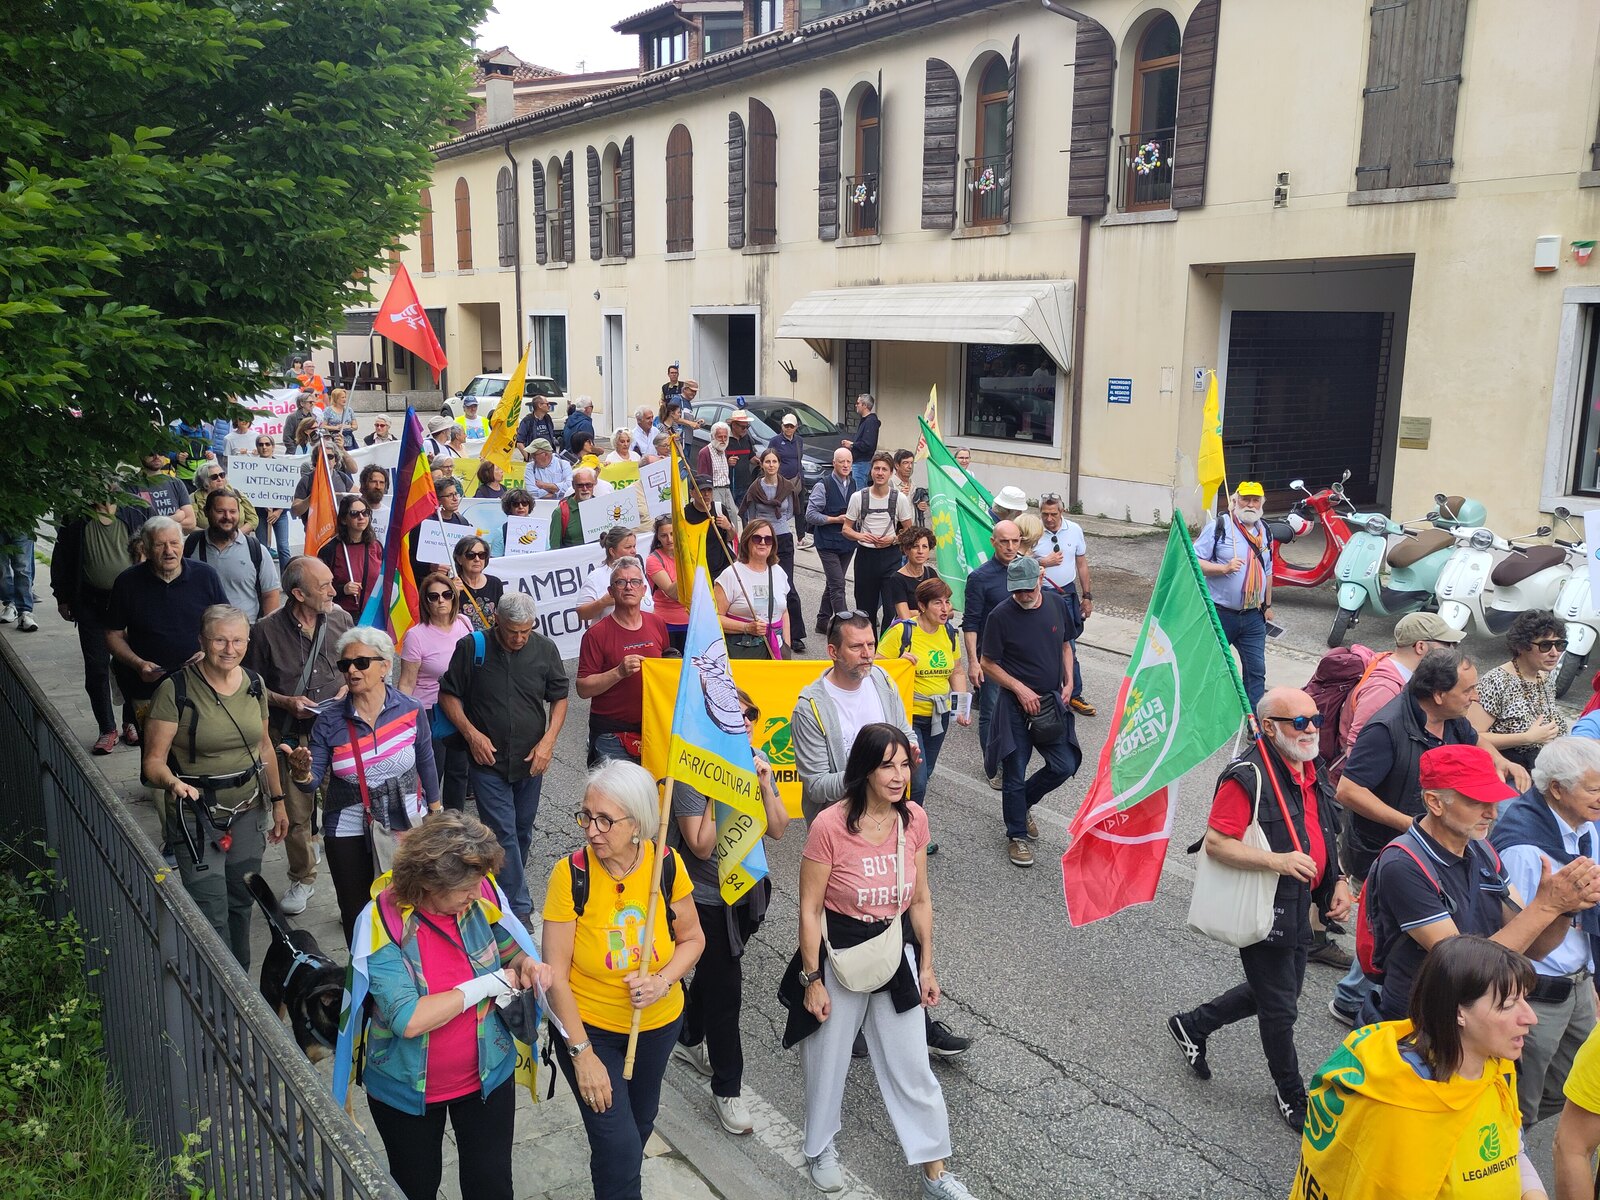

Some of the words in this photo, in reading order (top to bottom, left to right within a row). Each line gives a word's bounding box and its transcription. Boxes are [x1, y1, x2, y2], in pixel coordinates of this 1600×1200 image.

[233, 461, 258, 471] STOP
[246, 476, 295, 488] INTENSIVI
[155, 498, 172, 507] THE
